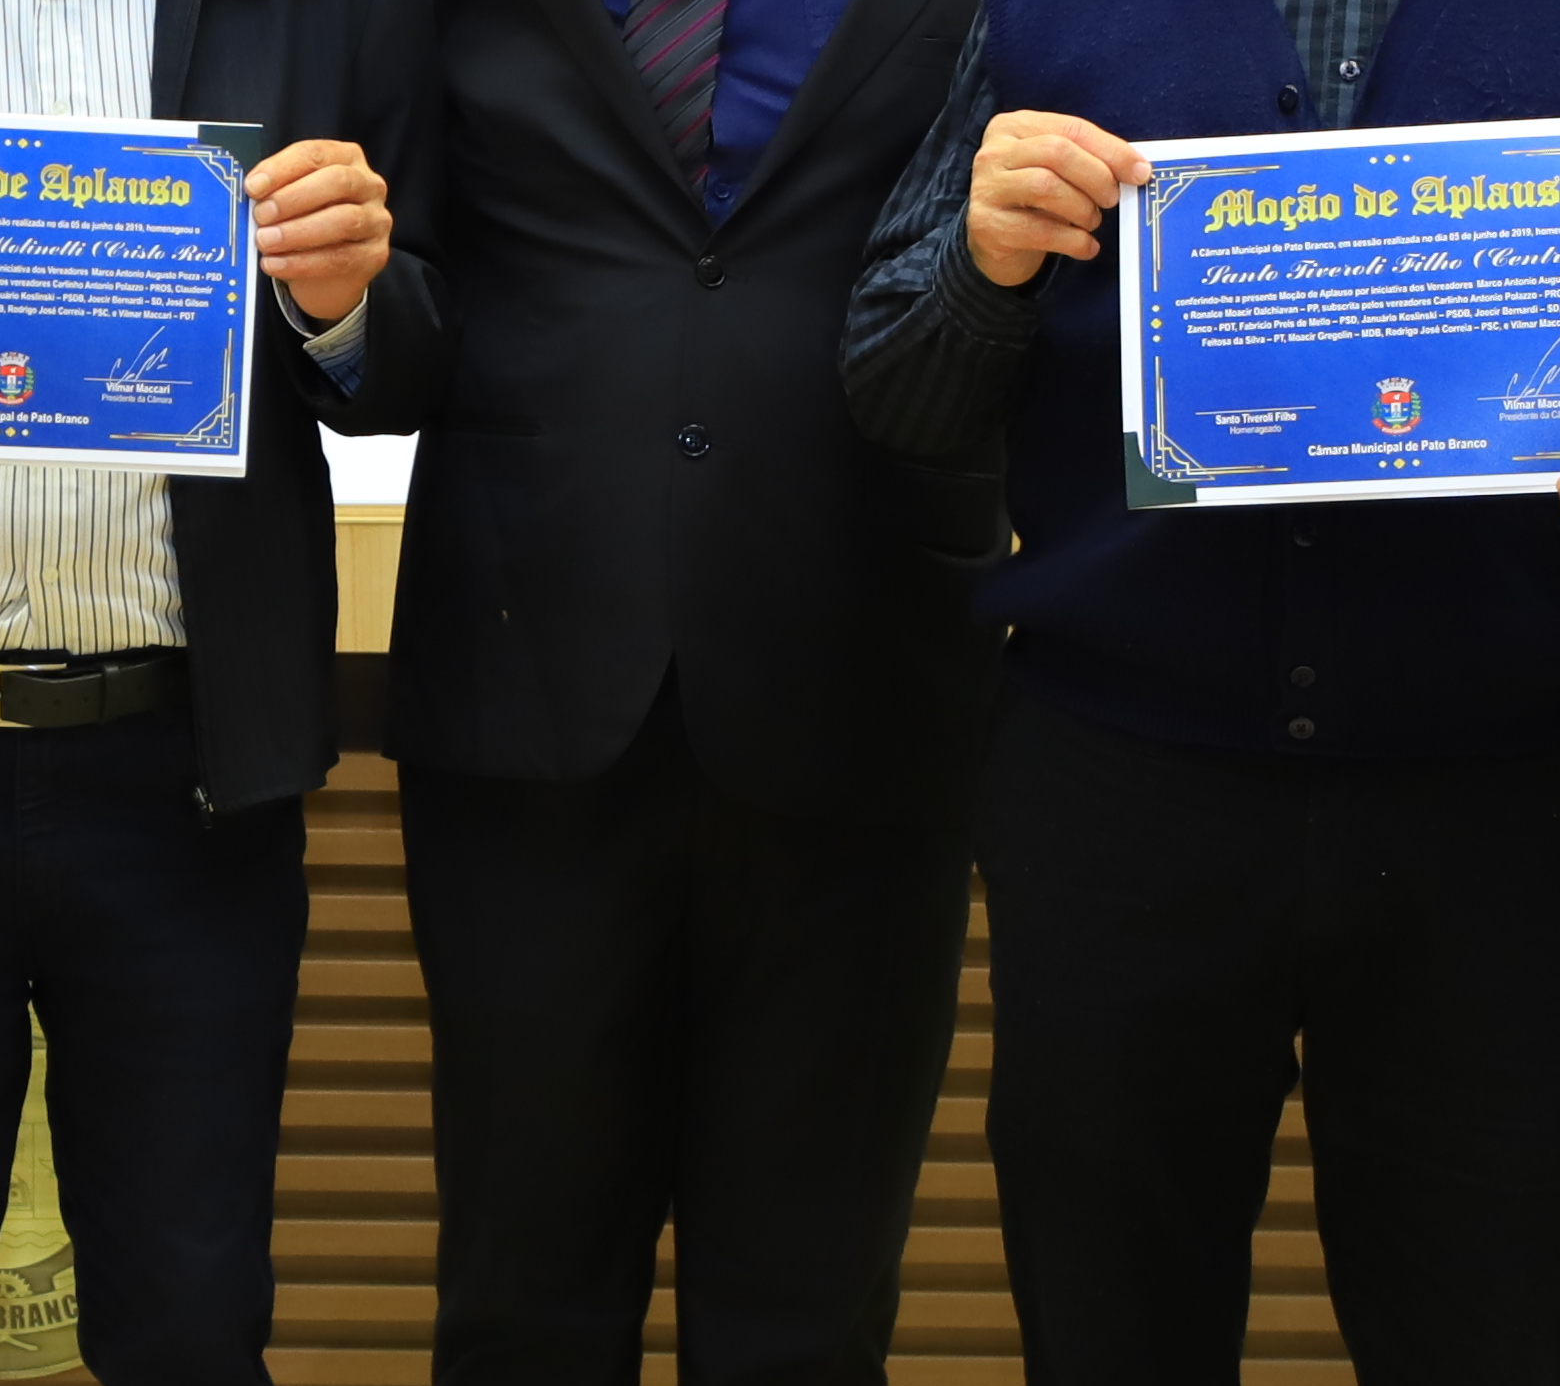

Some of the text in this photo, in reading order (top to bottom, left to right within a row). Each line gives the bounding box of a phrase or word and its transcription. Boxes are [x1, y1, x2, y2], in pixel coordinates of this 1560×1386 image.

[38, 163, 191, 210] Aplauso
[1204, 183, 1342, 234] Moção
[1353, 182, 1399, 219] de
[105, 381, 171, 394] Vilmar Maccari
[1503, 398, 1536, 411] Vilmar
[16, 411, 29, 423] de
[30, 411, 53, 424] Pato
[54, 412, 90, 425] Branco
[1307, 438, 1488, 457] Câmara Municipal de Pato Branco
